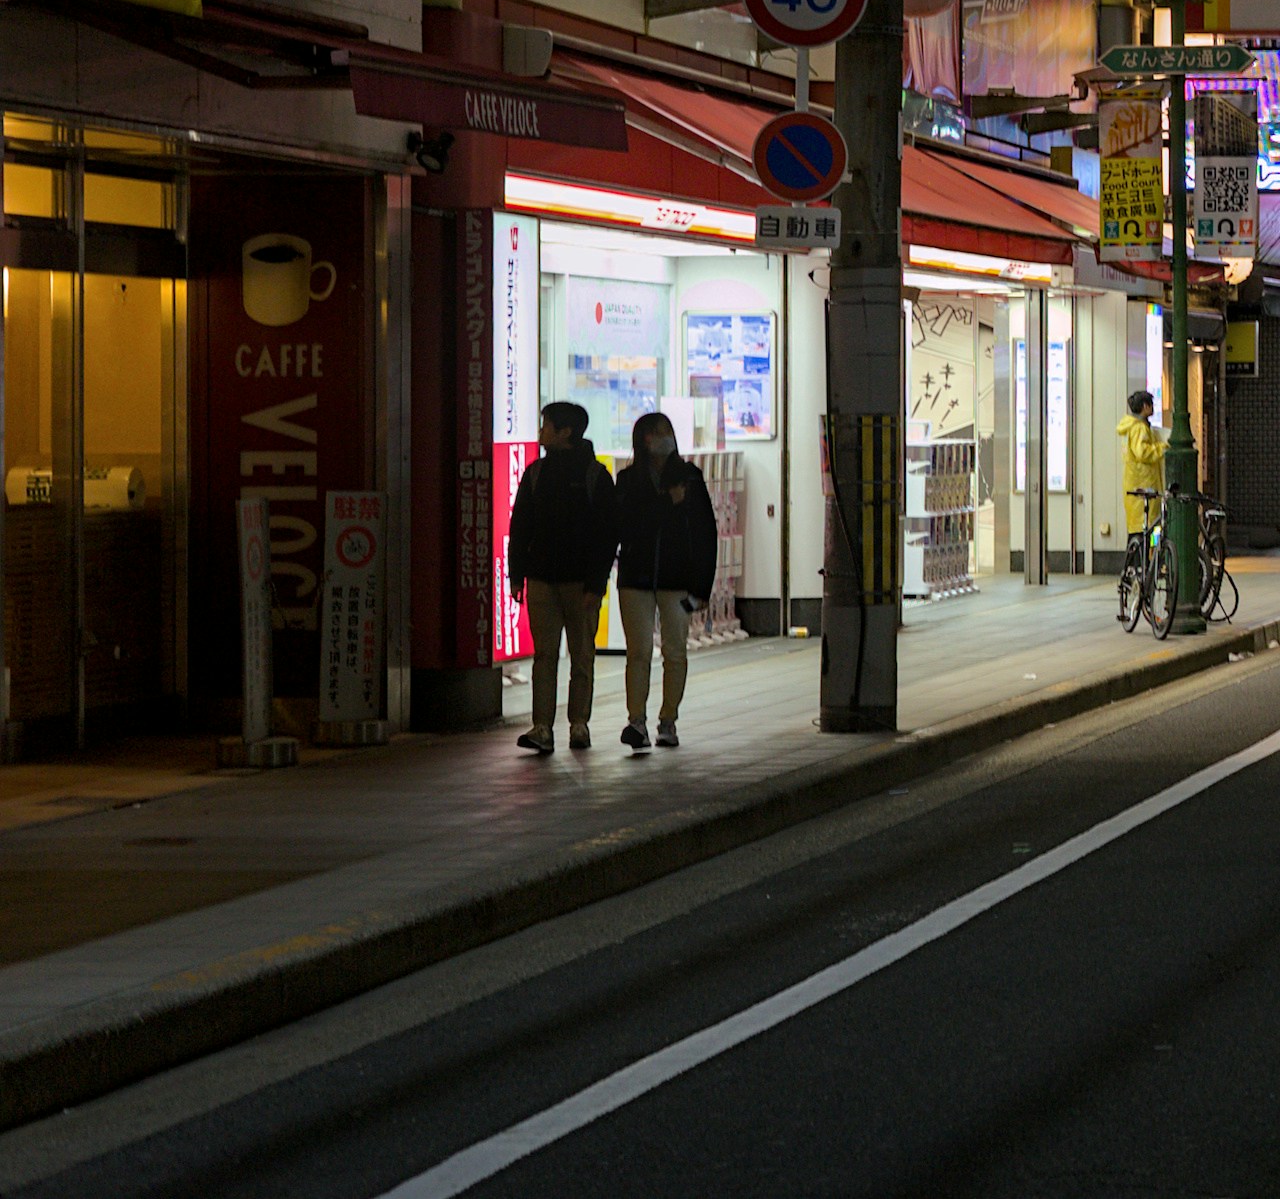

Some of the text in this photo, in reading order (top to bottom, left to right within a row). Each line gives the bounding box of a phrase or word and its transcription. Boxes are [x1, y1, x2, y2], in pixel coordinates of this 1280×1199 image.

[1120, 49, 1233, 69] なんさん通り
[498, 97, 541, 139] VELOCE
[1102, 165, 1162, 182] フードホール
[1102, 179, 1161, 192] Food Court
[759, 215, 837, 240] 自動車
[234, 342, 325, 380] CAFFE
